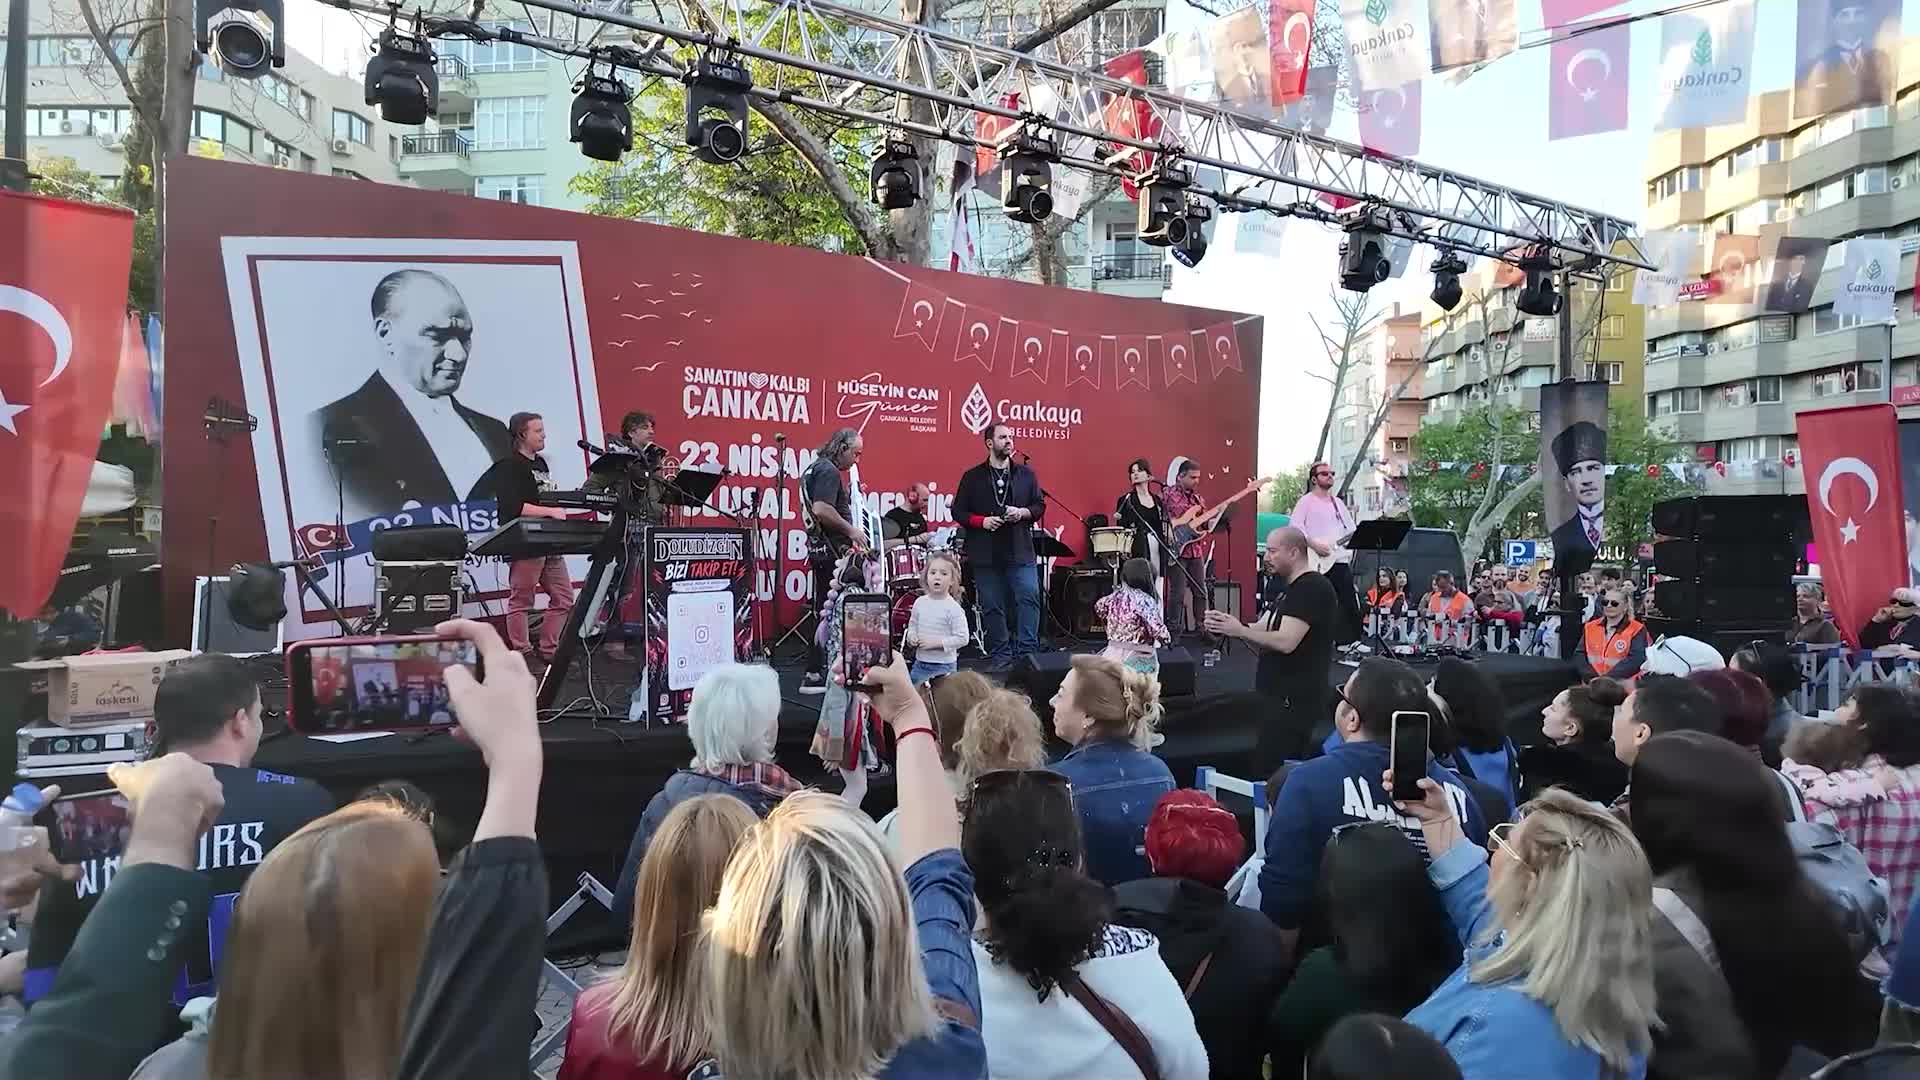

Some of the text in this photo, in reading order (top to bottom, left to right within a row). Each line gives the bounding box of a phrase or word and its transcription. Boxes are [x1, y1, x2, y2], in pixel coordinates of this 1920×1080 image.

[684, 366, 748, 388] SANATIN
[837, 379, 939, 401] HÜSEYİN CAN
[683, 384, 810, 424] ÇANKAYA
[837, 373, 938, 435] Güner
[996, 399, 1083, 427] Çankaya
[880, 415, 909, 423] ÇANKAYA
[1008, 426, 1071, 440] BELEDİYESİ
[679, 440, 720, 471] 23
[1509, 542, 1527, 566] P
[665, 560, 738, 581] BİZİ TAKİP ET!
